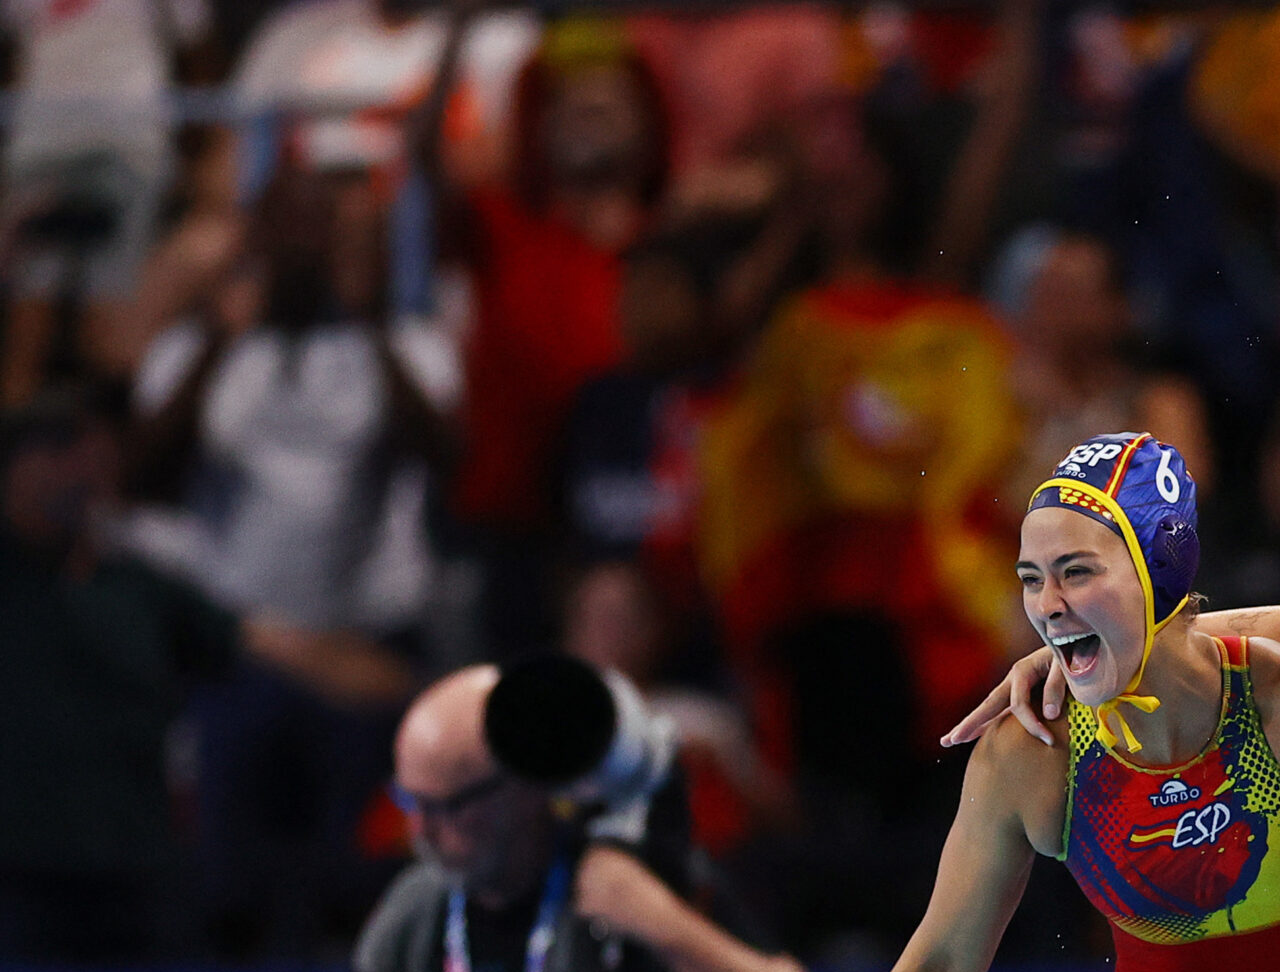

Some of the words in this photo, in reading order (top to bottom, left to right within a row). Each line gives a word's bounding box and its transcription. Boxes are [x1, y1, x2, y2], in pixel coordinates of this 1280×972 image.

[1059, 443, 1122, 467] ESP
[1156, 450, 1180, 503] 6
[1150, 788, 1200, 806] TURBO
[1173, 803, 1231, 848] ESP
